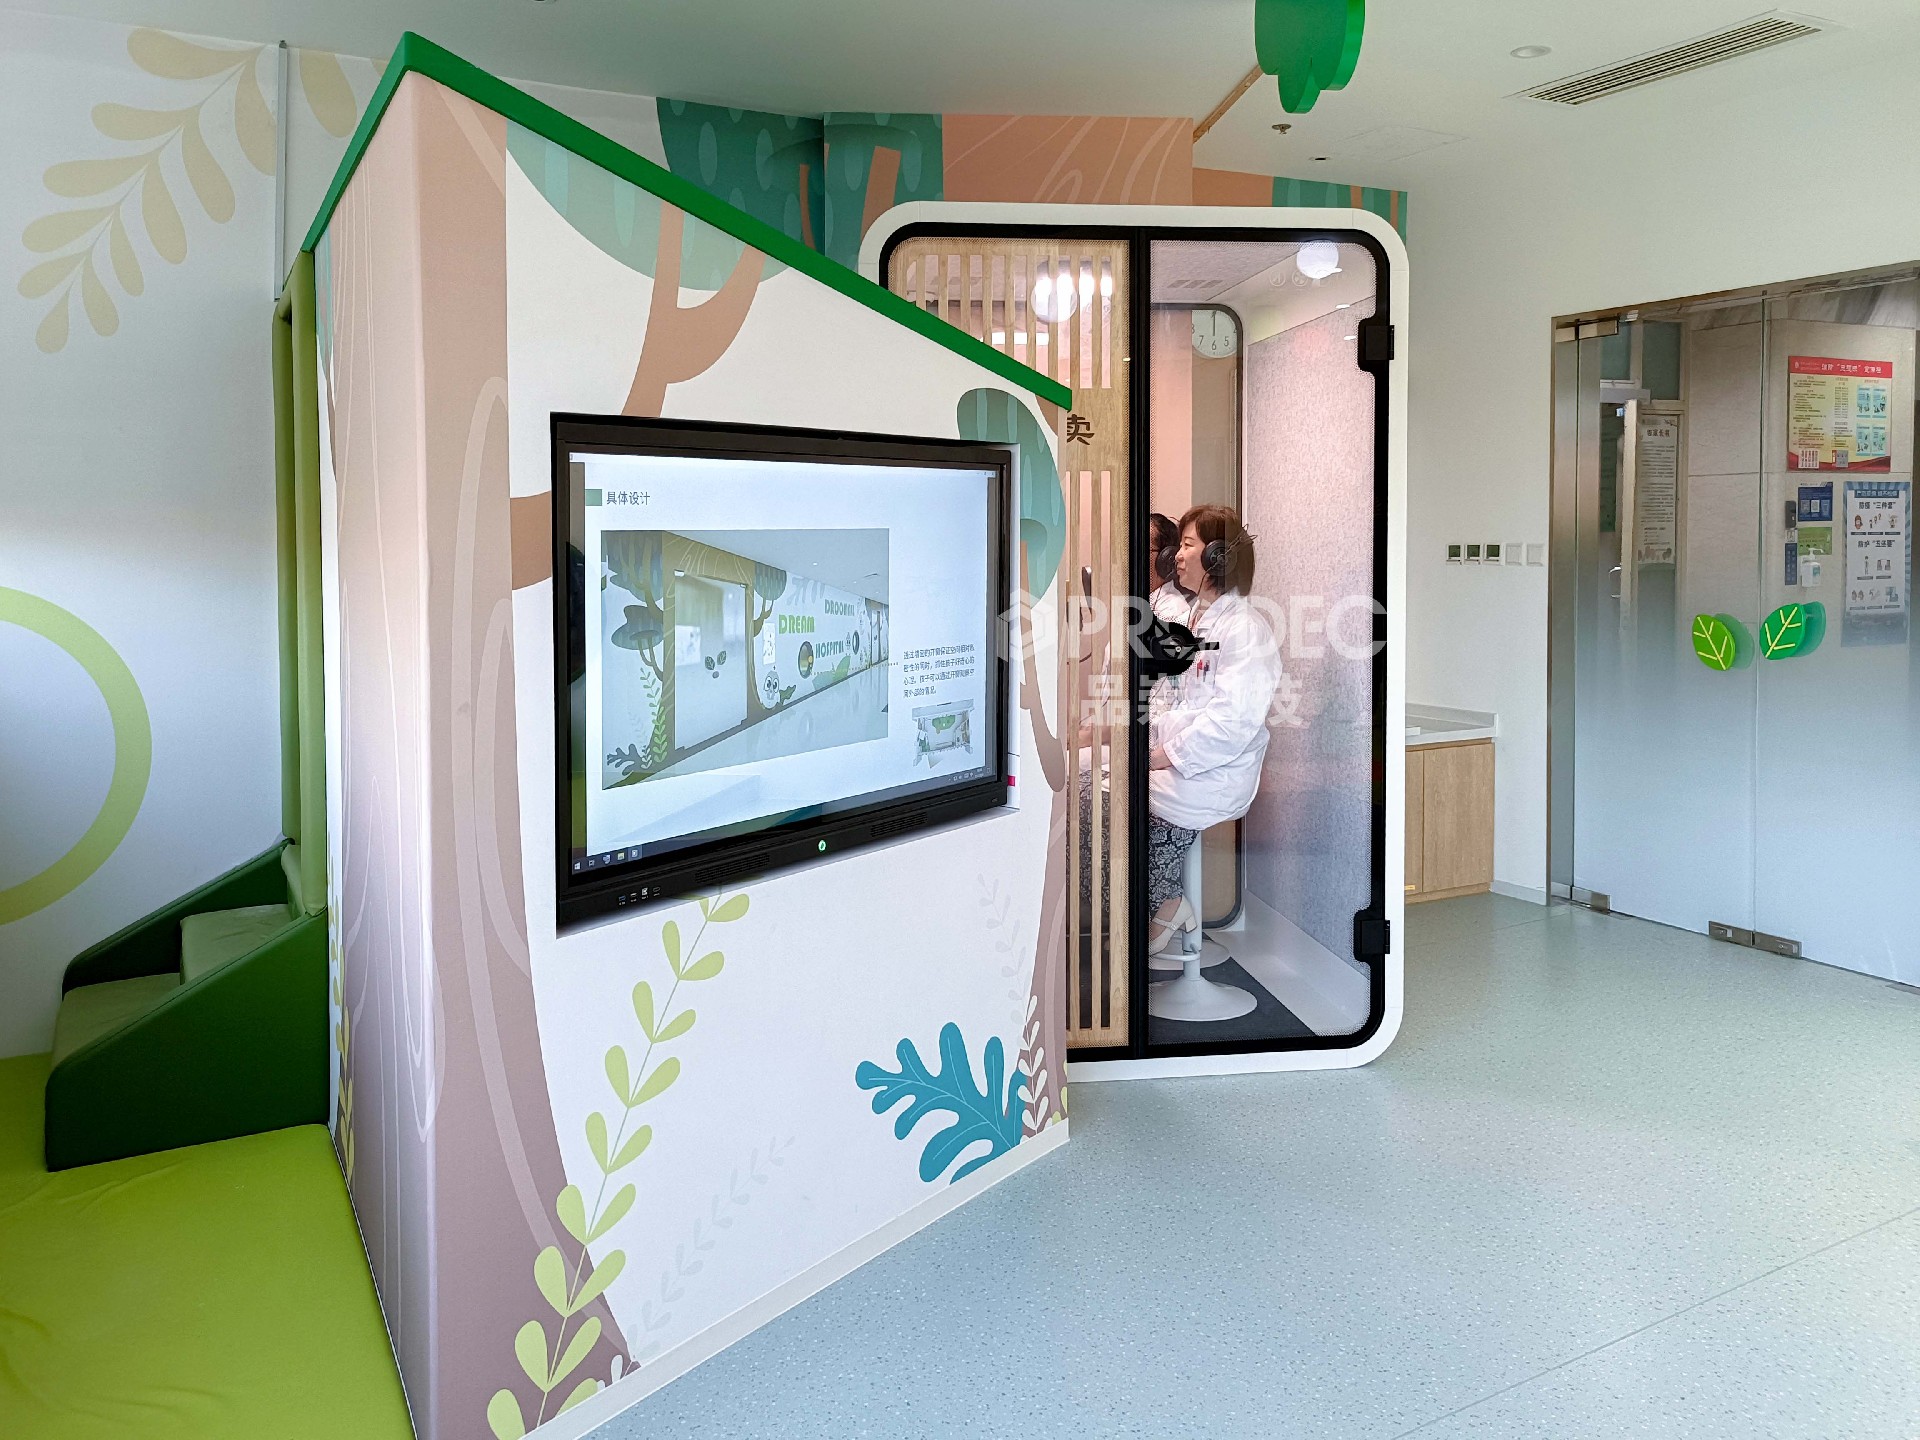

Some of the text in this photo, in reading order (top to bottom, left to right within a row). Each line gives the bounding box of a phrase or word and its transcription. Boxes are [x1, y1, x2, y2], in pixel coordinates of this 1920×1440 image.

[1198, 335, 1205, 346] 7
[1211, 339, 1217, 351] 6
[1223, 335, 1230, 347] 5
[606, 490, 651, 506] 具体设计
[778, 614, 815, 635] DREAM
